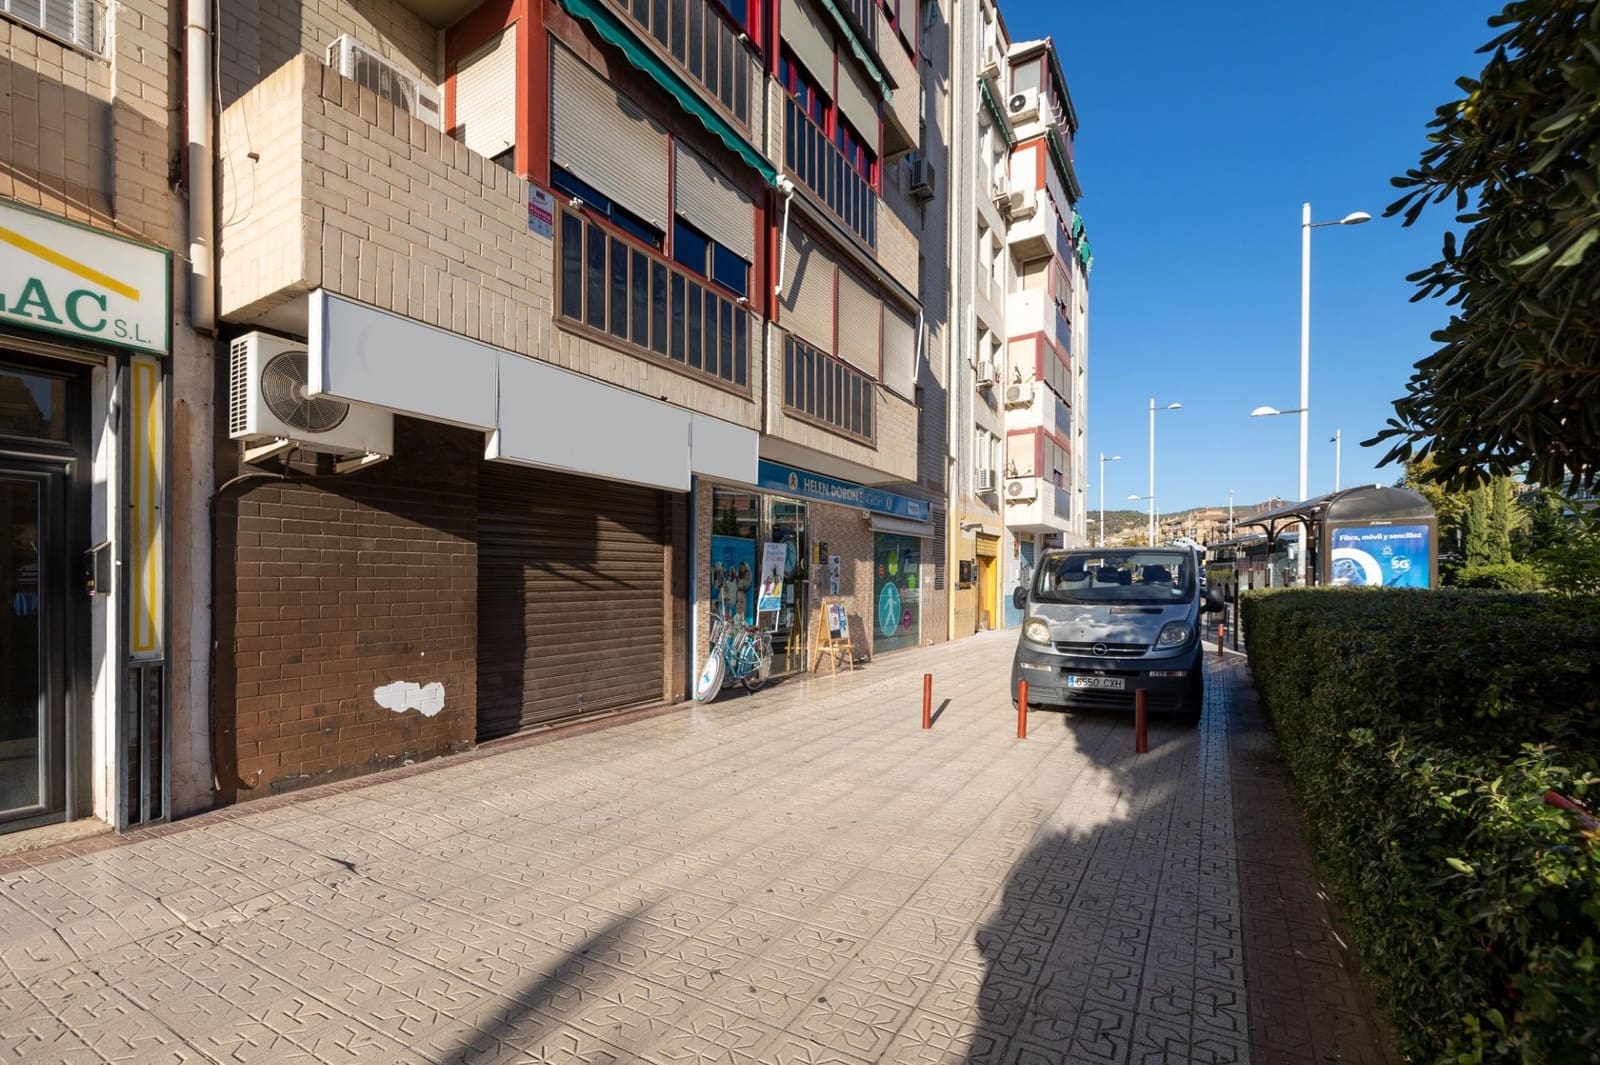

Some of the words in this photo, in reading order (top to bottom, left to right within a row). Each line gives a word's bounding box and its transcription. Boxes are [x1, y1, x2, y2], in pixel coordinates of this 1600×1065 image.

[0, 277, 107, 333] AC
[113, 319, 152, 344] S.L.
[803, 477, 829, 496] HELEN
[831, 485, 859, 502] DORON
[1361, 532, 1382, 540] móvil
[1389, 532, 1422, 540] sencillez
[1391, 559, 1409, 569] 5G
[1076, 677, 1100, 688] 6550
[1103, 679, 1122, 689] CXH
